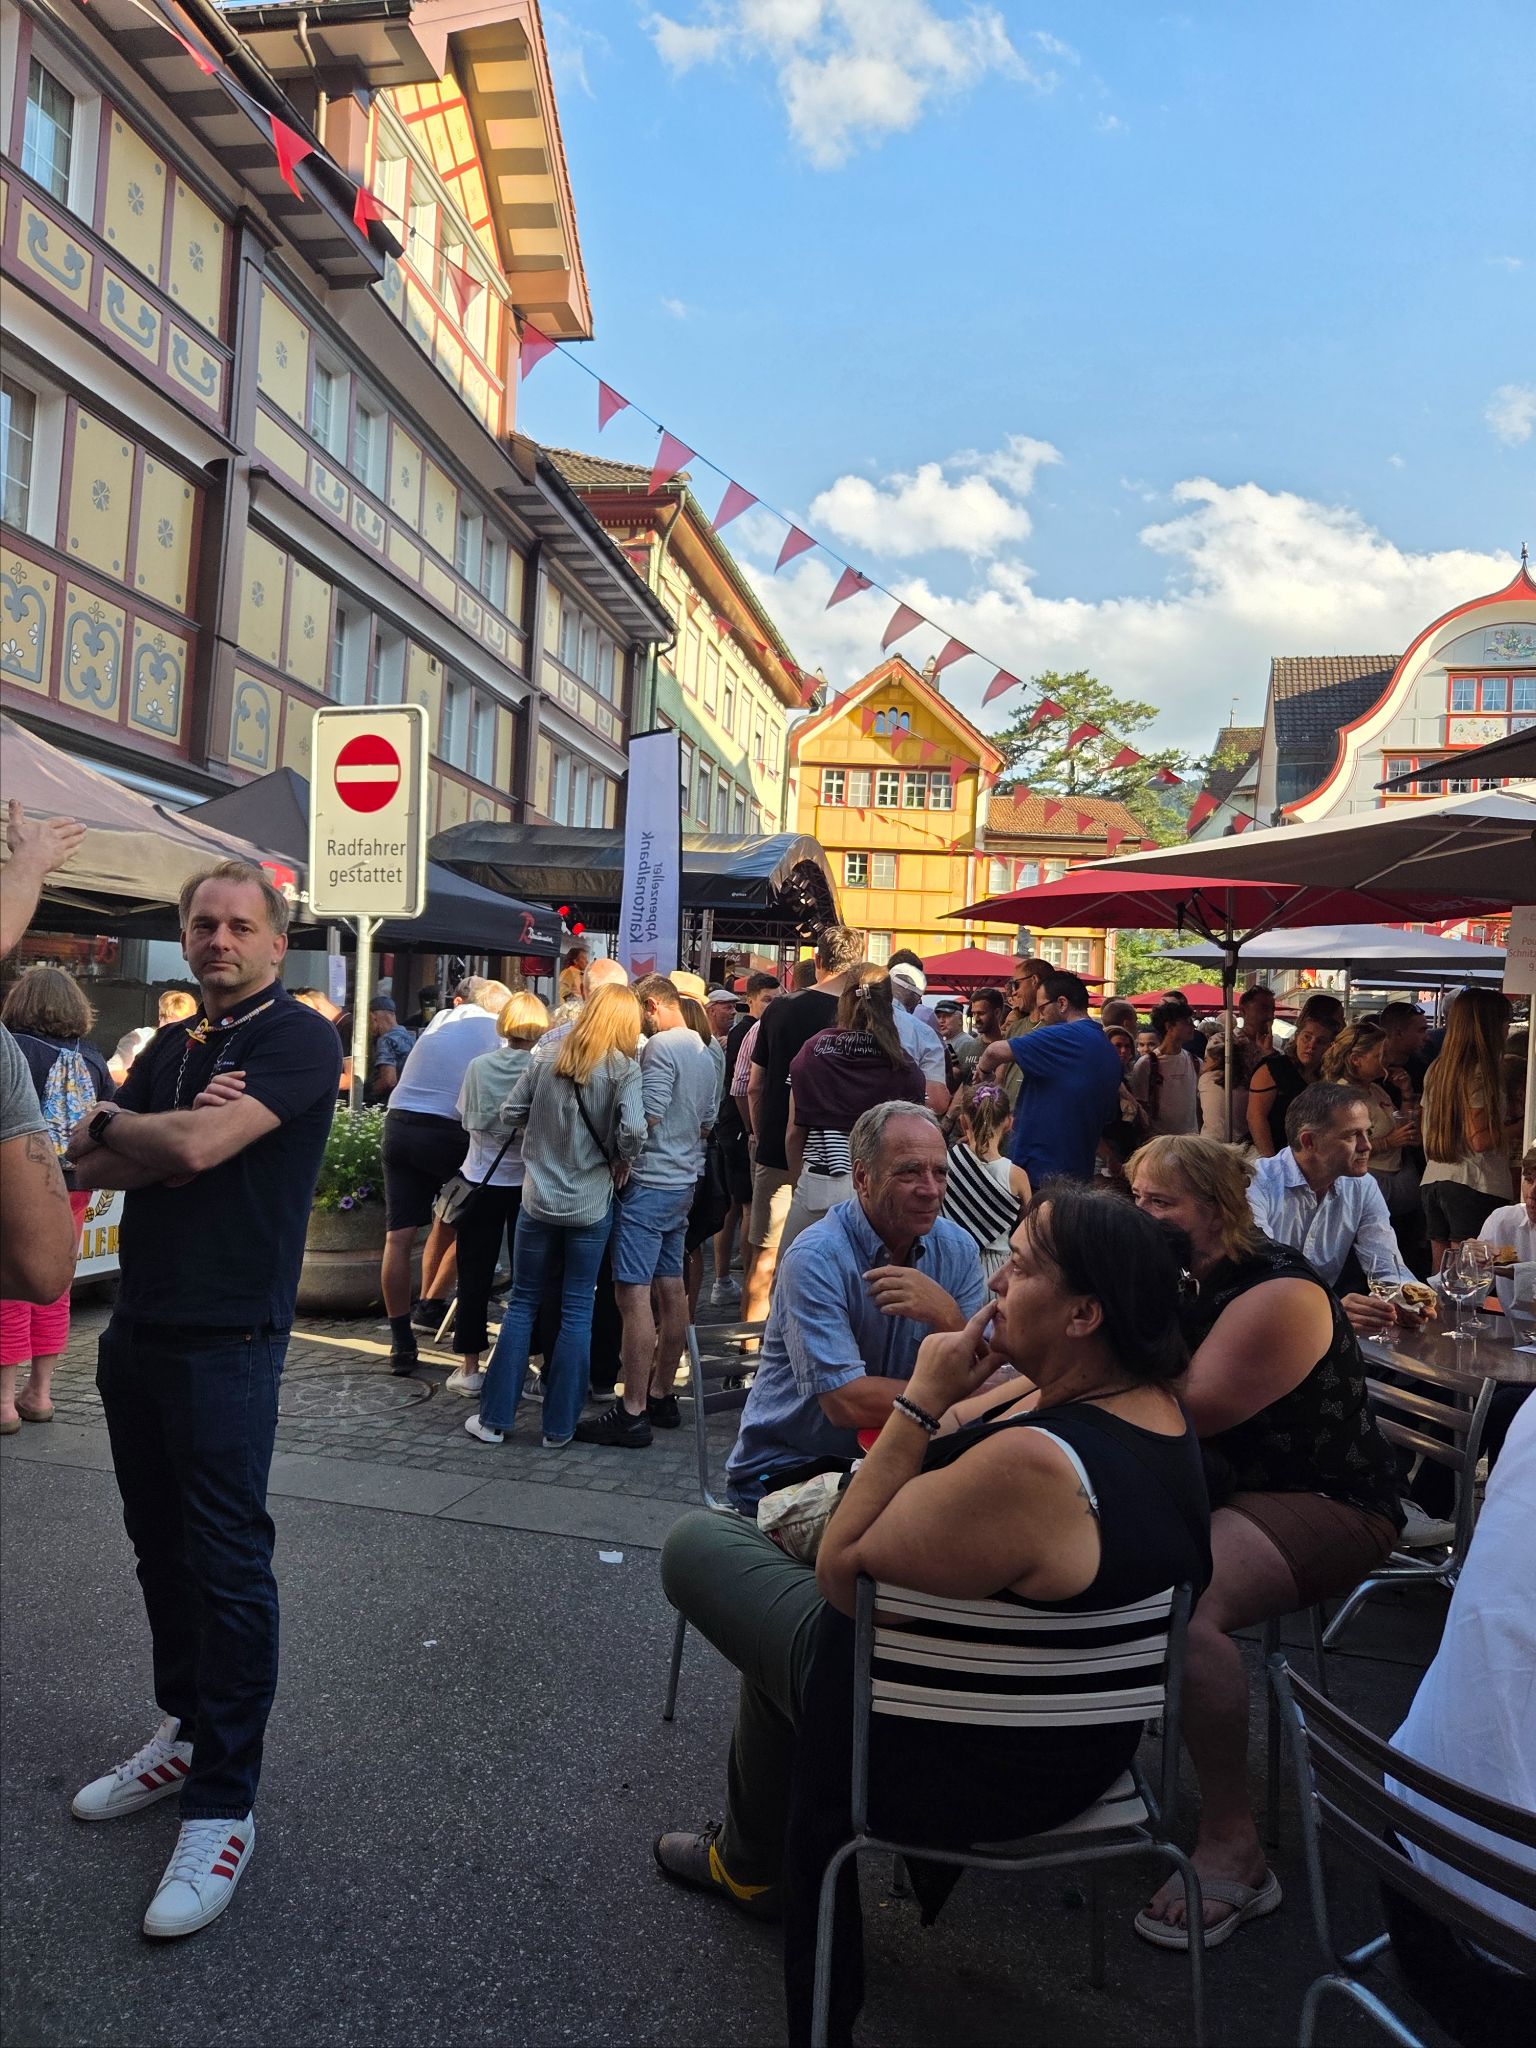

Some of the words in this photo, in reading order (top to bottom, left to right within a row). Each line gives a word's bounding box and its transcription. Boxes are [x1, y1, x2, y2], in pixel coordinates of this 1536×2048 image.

[327, 838, 406, 856] Radfahrer
[329, 867, 402, 887] gestattet
[76, 1225, 120, 1261] LER
